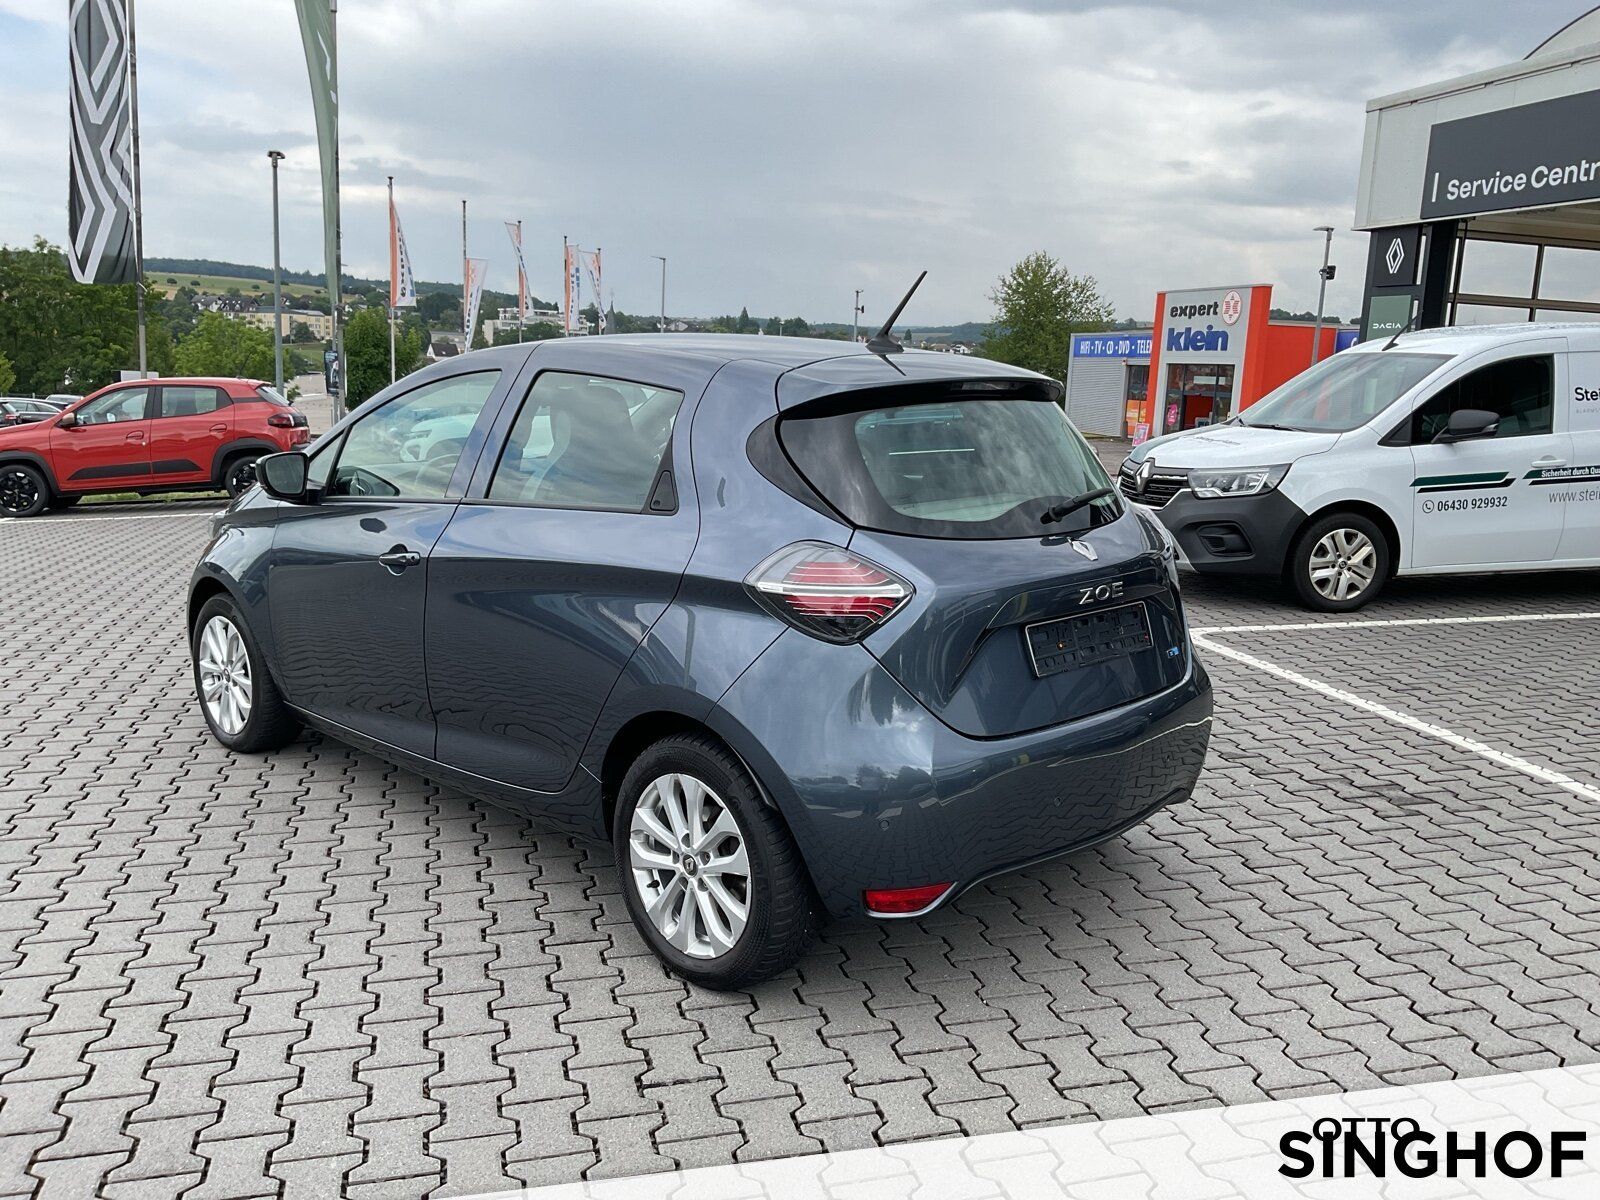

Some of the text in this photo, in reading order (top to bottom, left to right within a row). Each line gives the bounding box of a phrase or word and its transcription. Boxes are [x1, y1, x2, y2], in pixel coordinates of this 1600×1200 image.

[1446, 159, 1600, 200] Service Centr
[1169, 301, 1219, 319] expert
[1372, 322, 1402, 330] DACIA
[1166, 324, 1229, 352] klein
[1094, 340, 1103, 354] TV
[1106, 340, 1114, 354] CD
[1118, 340, 1130, 354] DVD
[1541, 468, 1572, 478] Sicherheit
[1572, 467, 1589, 476] durch
[1437, 496, 1508, 512] 06430 929932
[1078, 581, 1124, 605] ZOE
